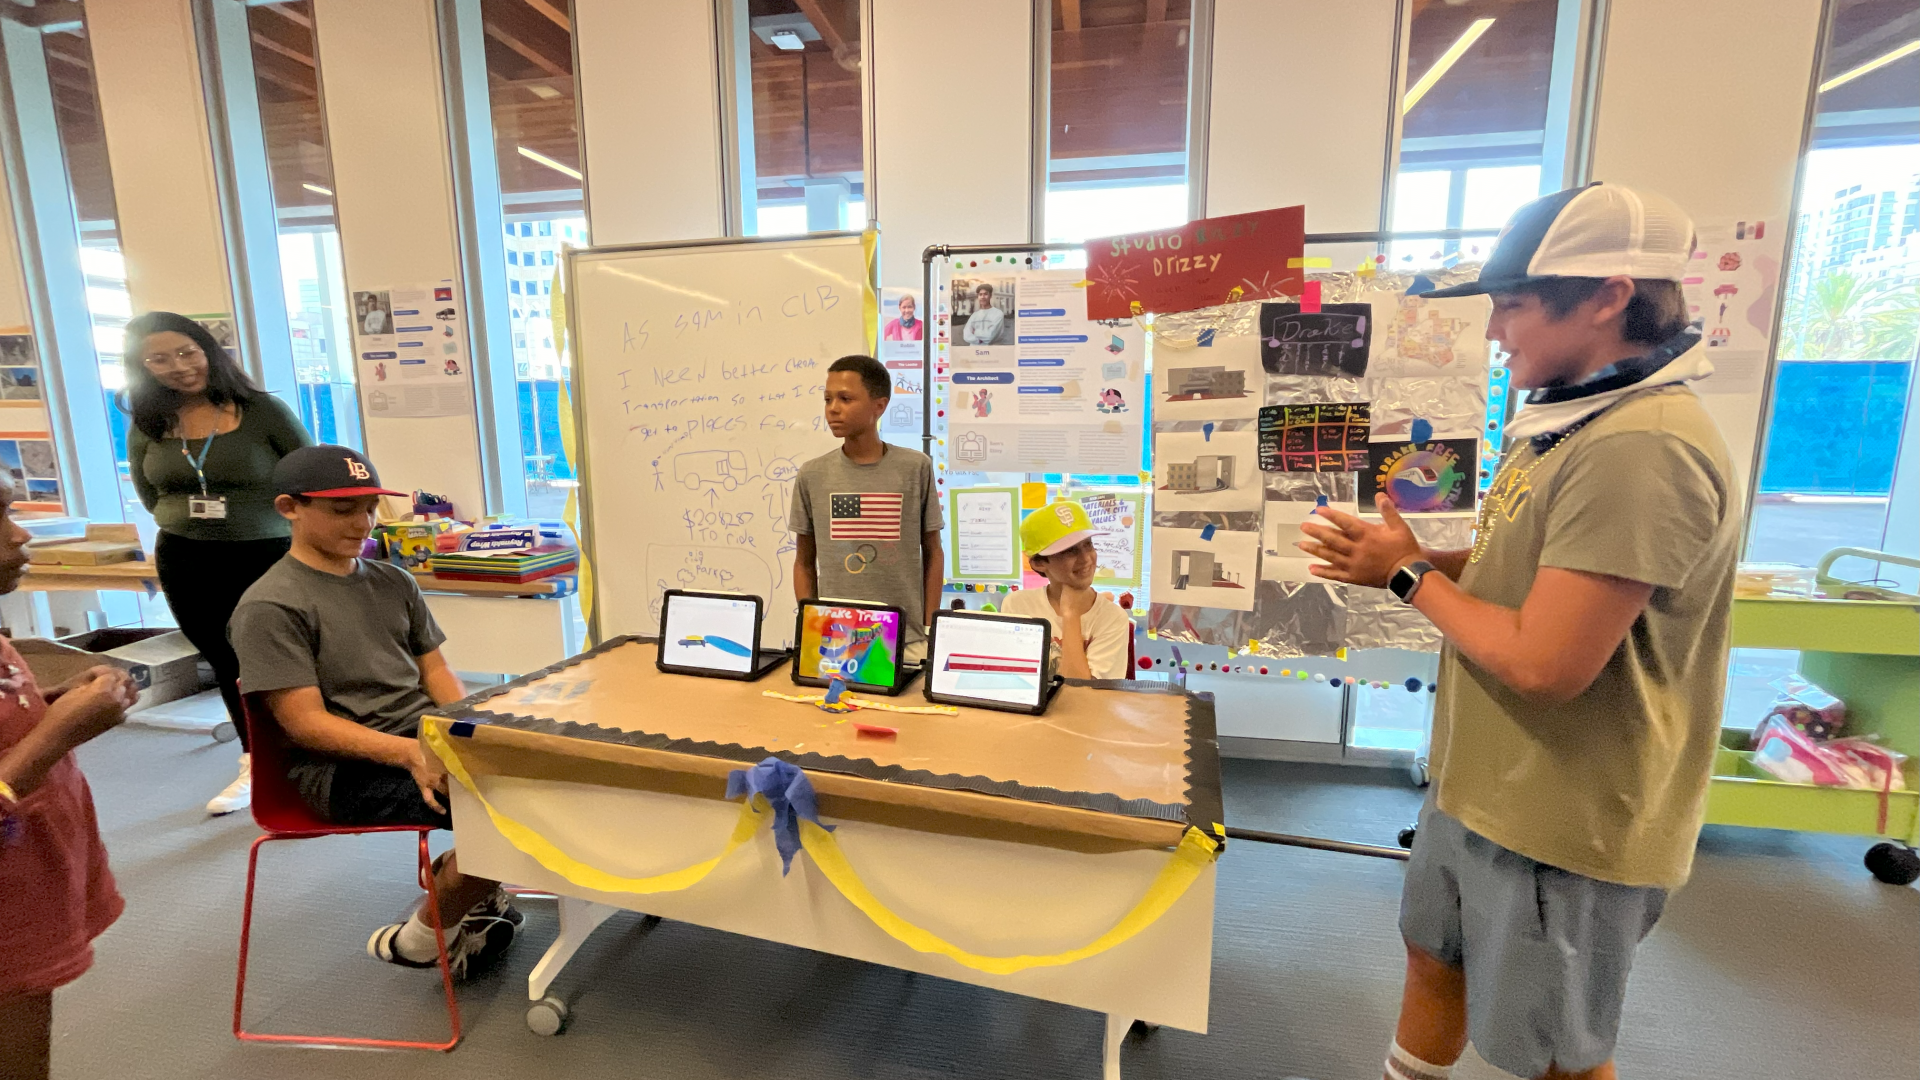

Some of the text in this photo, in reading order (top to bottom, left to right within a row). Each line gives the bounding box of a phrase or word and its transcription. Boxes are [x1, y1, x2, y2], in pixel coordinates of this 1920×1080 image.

[1153, 253, 1222, 277] Drizzy
[737, 301, 762, 325] in
[781, 285, 839, 318] CLB
[617, 369, 632, 390] I
[1119, 497, 1125, 505] &
[1112, 504, 1129, 514] CITY
[1091, 514, 1117, 525] VALUES
[469, 538, 524, 549] Reynolds Wrap
[726, 529, 757, 548] ride
